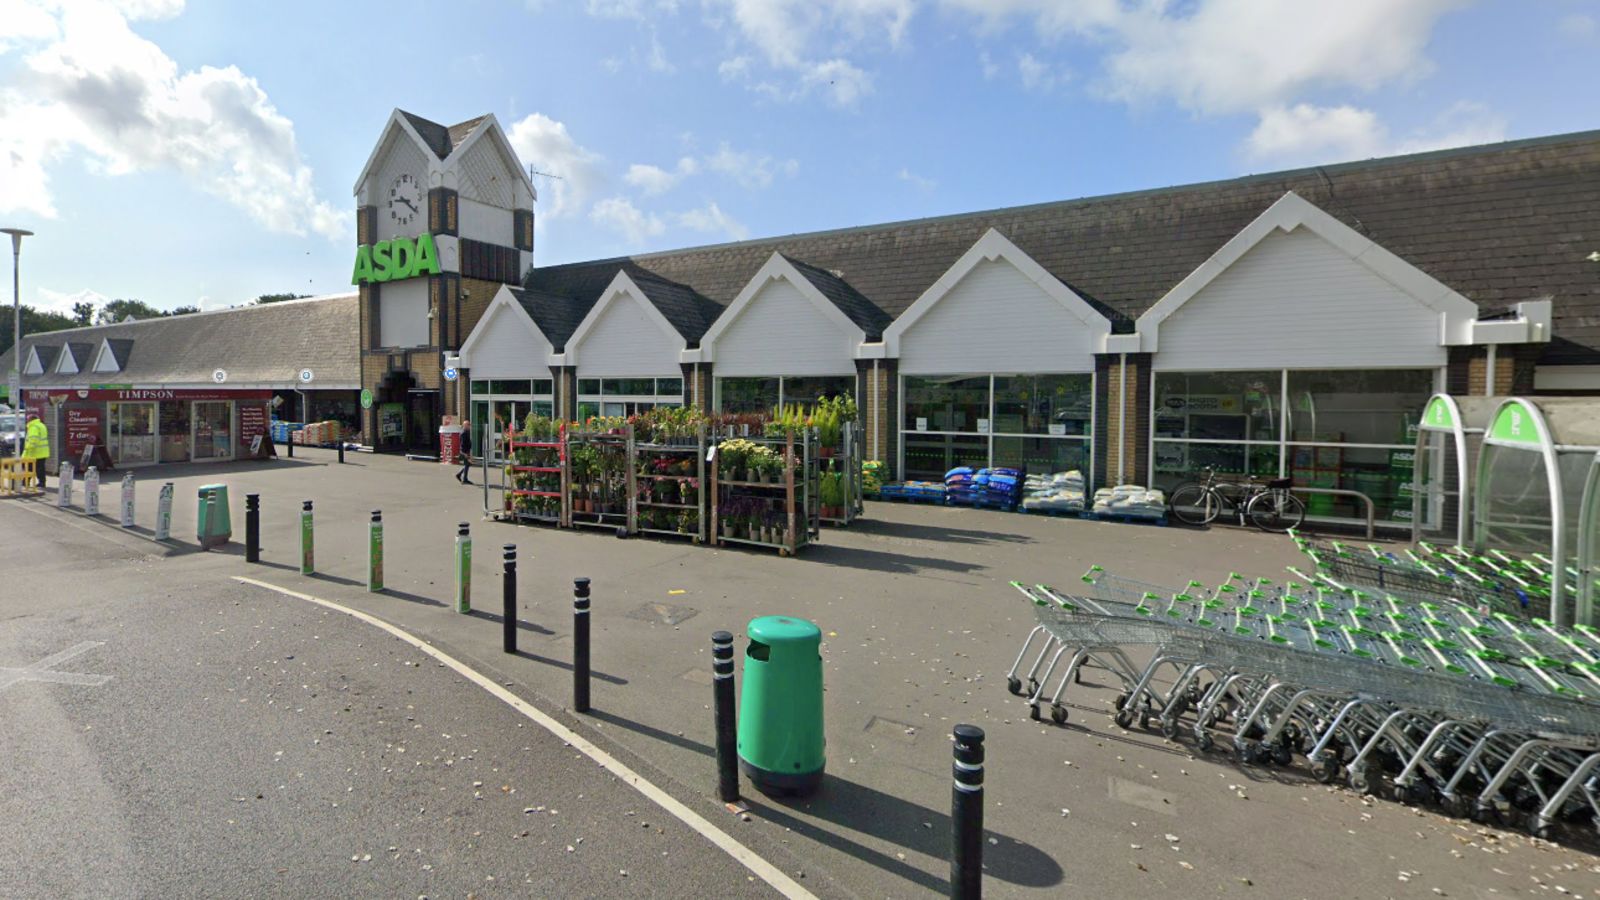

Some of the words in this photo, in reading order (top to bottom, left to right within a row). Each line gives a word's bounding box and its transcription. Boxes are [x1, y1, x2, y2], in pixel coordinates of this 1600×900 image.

[352, 233, 441, 285] ASDA
[118, 390, 174, 399] TIMPSON
[1393, 510, 1413, 518] ASD
